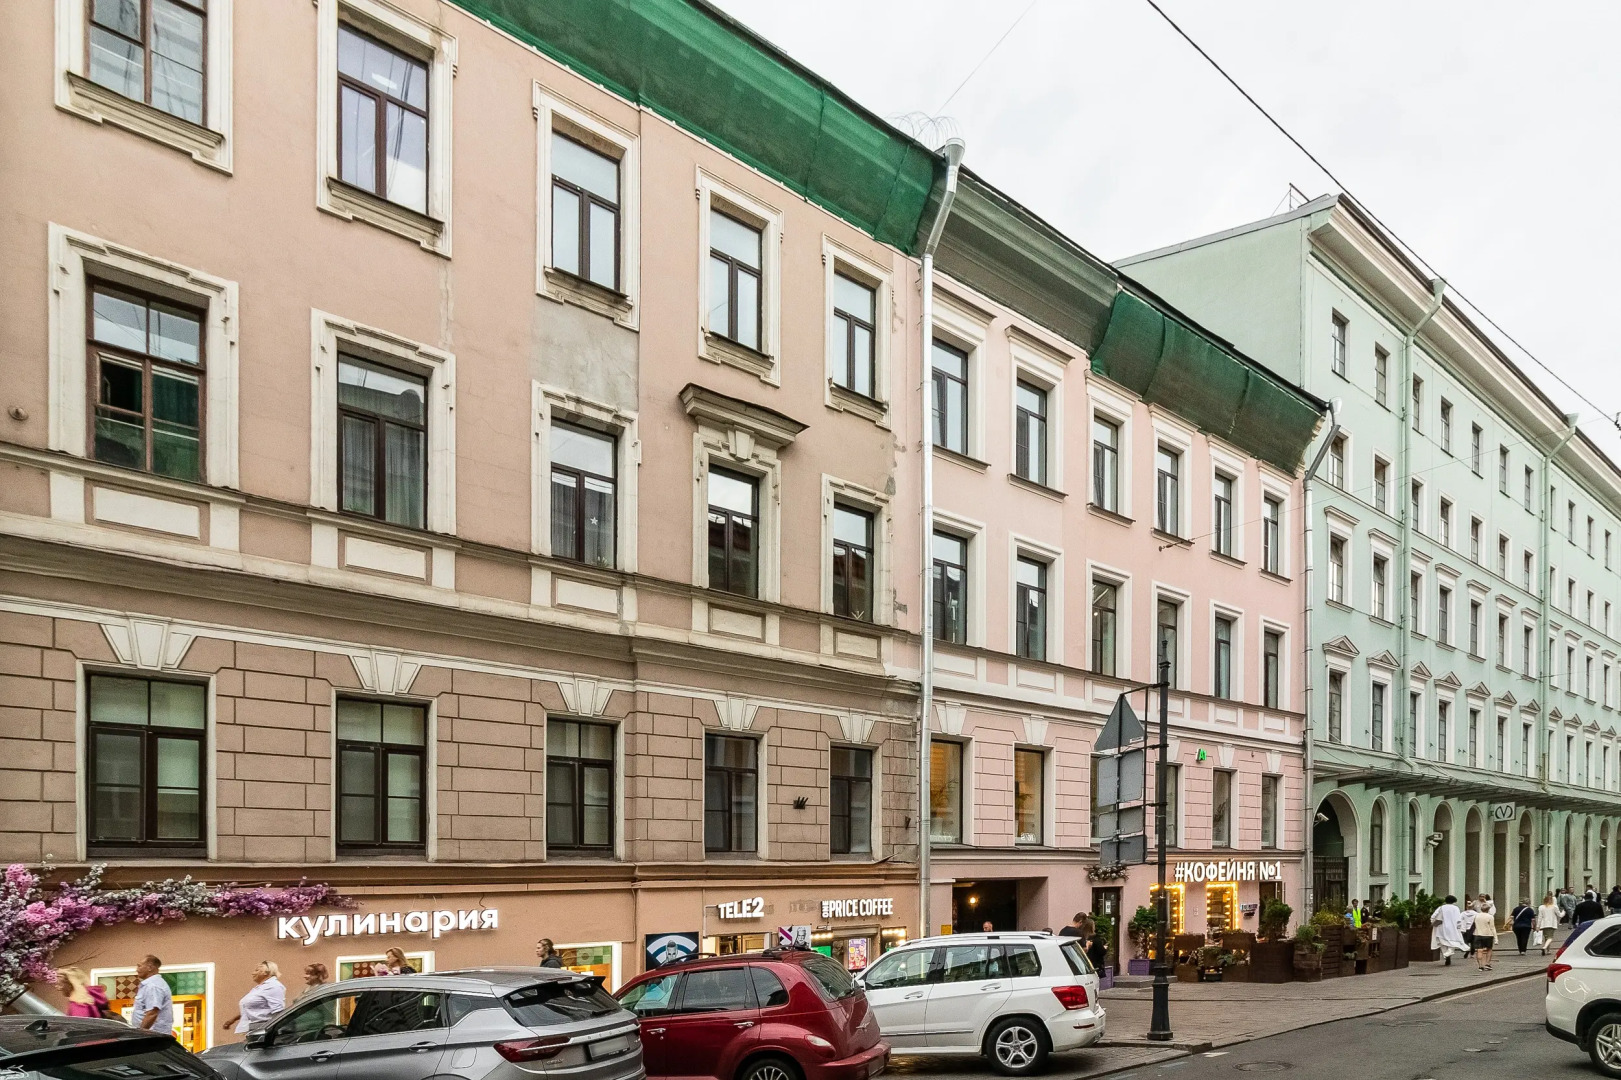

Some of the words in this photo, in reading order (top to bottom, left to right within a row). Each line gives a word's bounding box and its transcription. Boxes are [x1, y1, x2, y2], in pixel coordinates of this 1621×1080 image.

[1174, 857, 1256, 883] #КОФЕЙНЯ
[1259, 860, 1282, 881] №1
[717, 896, 765, 919] TELE2
[821, 900, 829, 918] ONE
[829, 898, 859, 918] PRICE
[859, 897, 894, 916] COFFEE
[277, 908, 499, 946] кулинария
